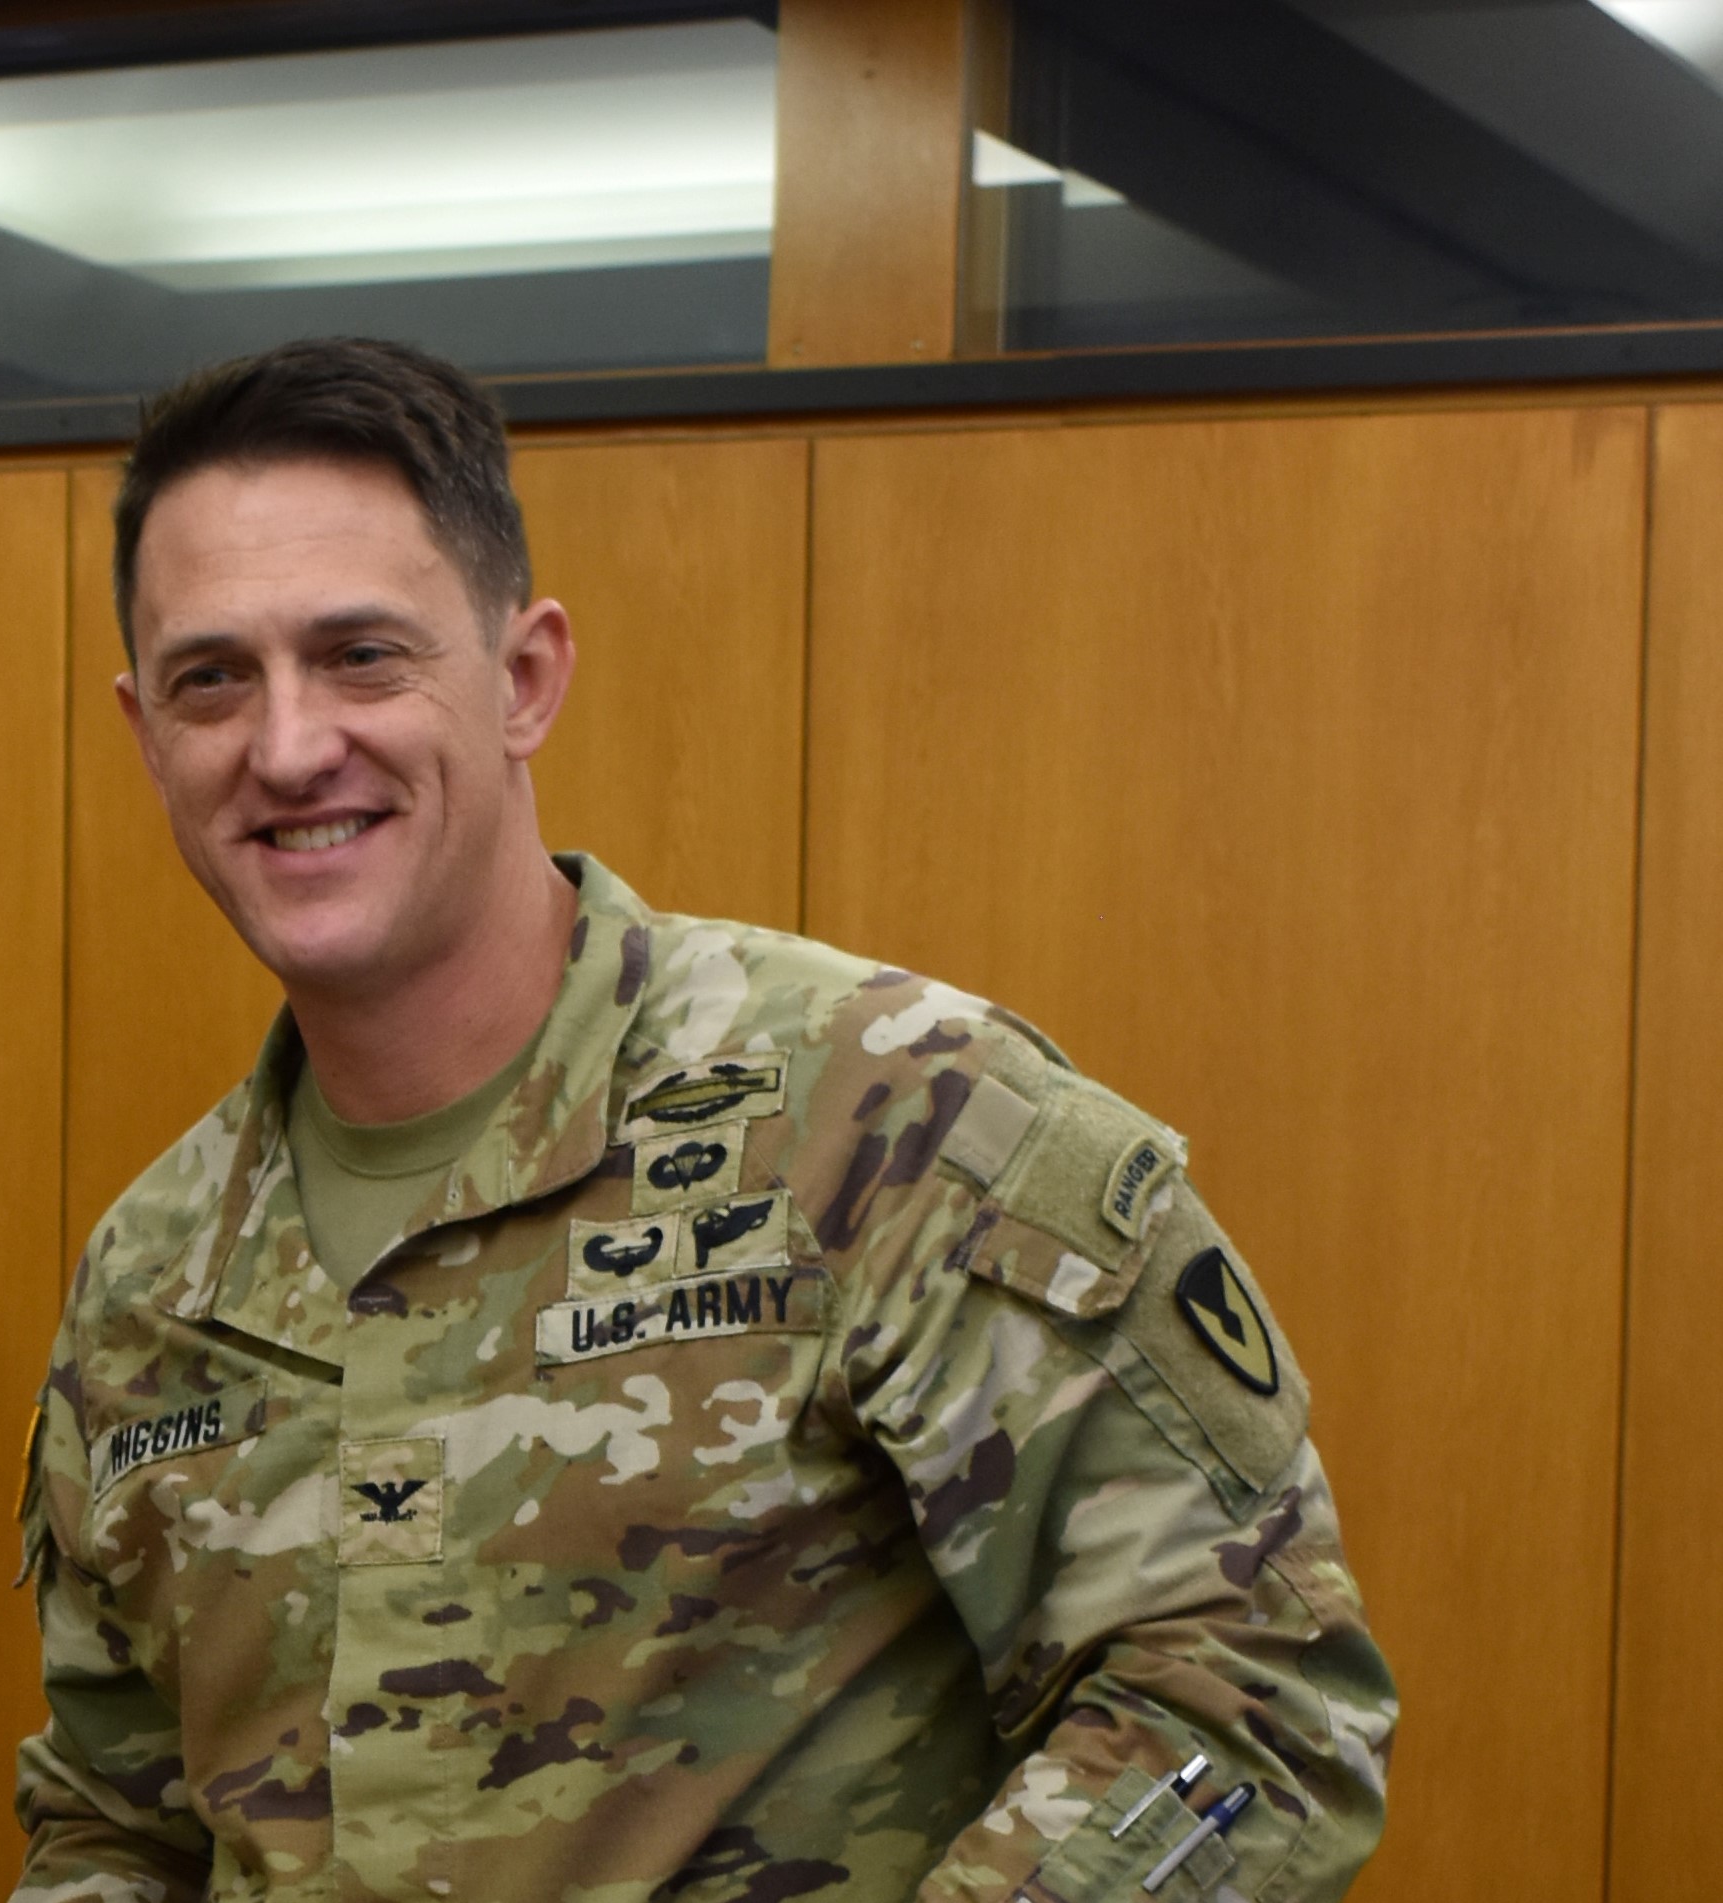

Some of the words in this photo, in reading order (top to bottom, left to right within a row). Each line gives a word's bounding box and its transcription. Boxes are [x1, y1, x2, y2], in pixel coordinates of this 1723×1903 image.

[1114, 1148, 1160, 1221] RANGER
[570, 1301, 647, 1353] U.S.
[664, 1275, 794, 1333] ARMY
